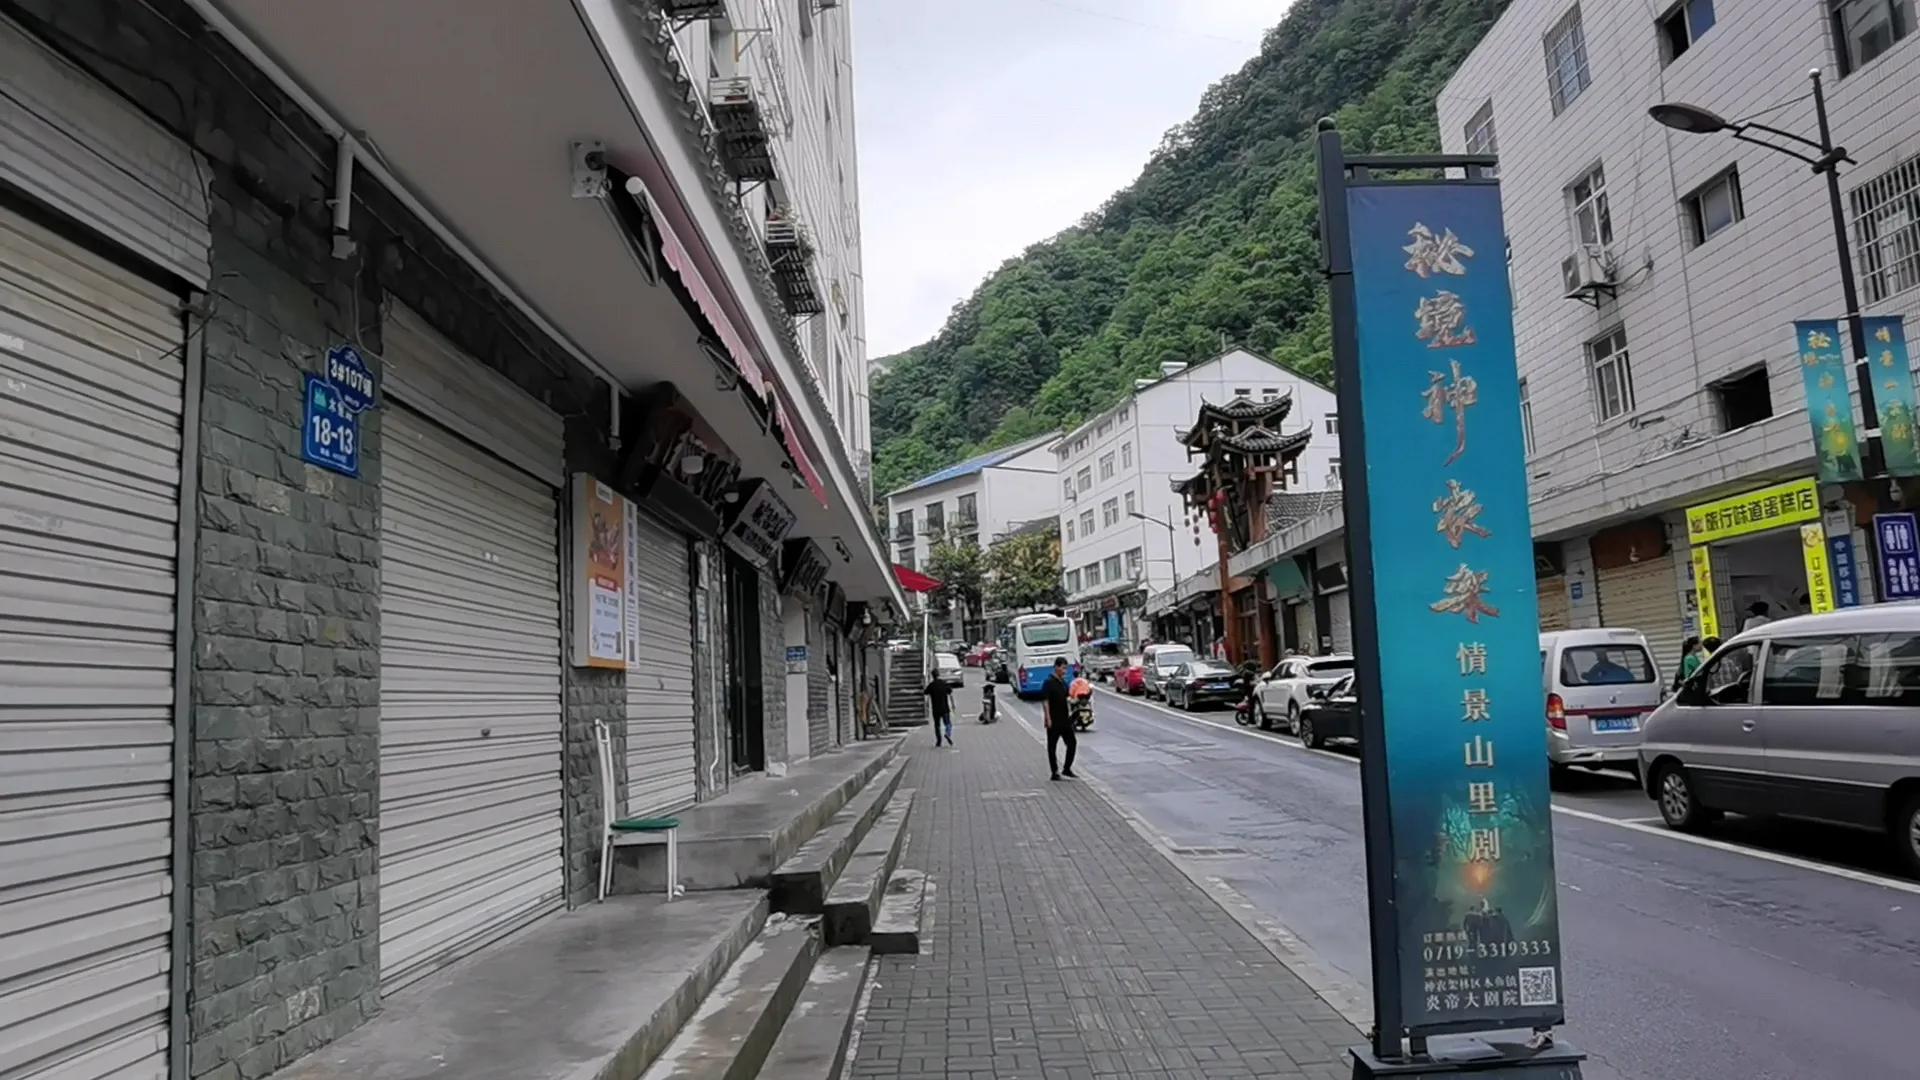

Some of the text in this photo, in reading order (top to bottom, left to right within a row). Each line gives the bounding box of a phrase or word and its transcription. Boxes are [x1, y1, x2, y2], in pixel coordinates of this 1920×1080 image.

[312, 416, 353, 455] 18-13
[1402, 222, 1499, 624] 秘境神农架
[1456, 641, 1500, 863] 情景山里剧
[1423, 940, 1551, 961] 0719-3319333
[1425, 990, 1518, 1012] 炎帝大剧院
